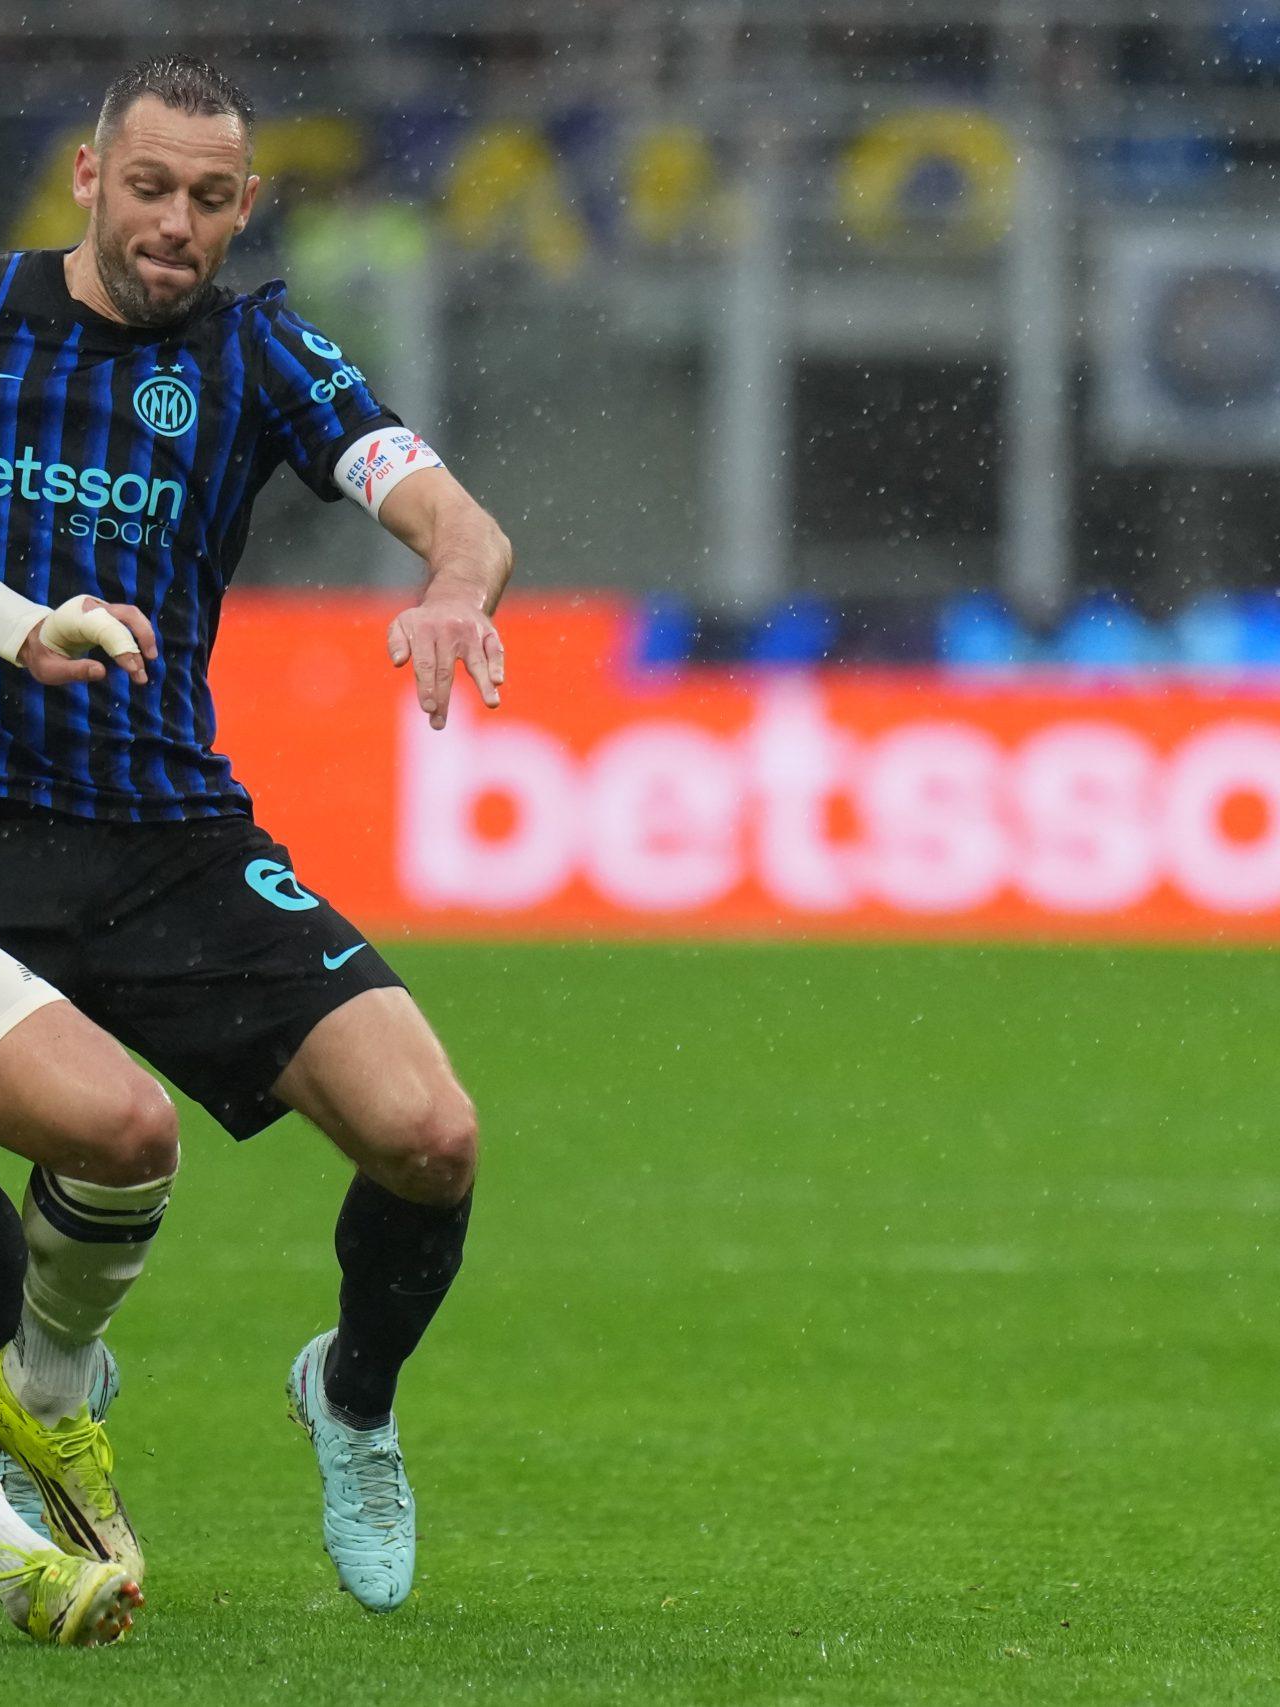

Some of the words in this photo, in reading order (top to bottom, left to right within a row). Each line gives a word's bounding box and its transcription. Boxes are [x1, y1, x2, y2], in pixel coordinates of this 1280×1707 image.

[346, 456, 365, 482] KEEP
[355, 454, 388, 490] RACISM
[375, 461, 394, 480] OUT
[245, 858, 320, 911] 6
